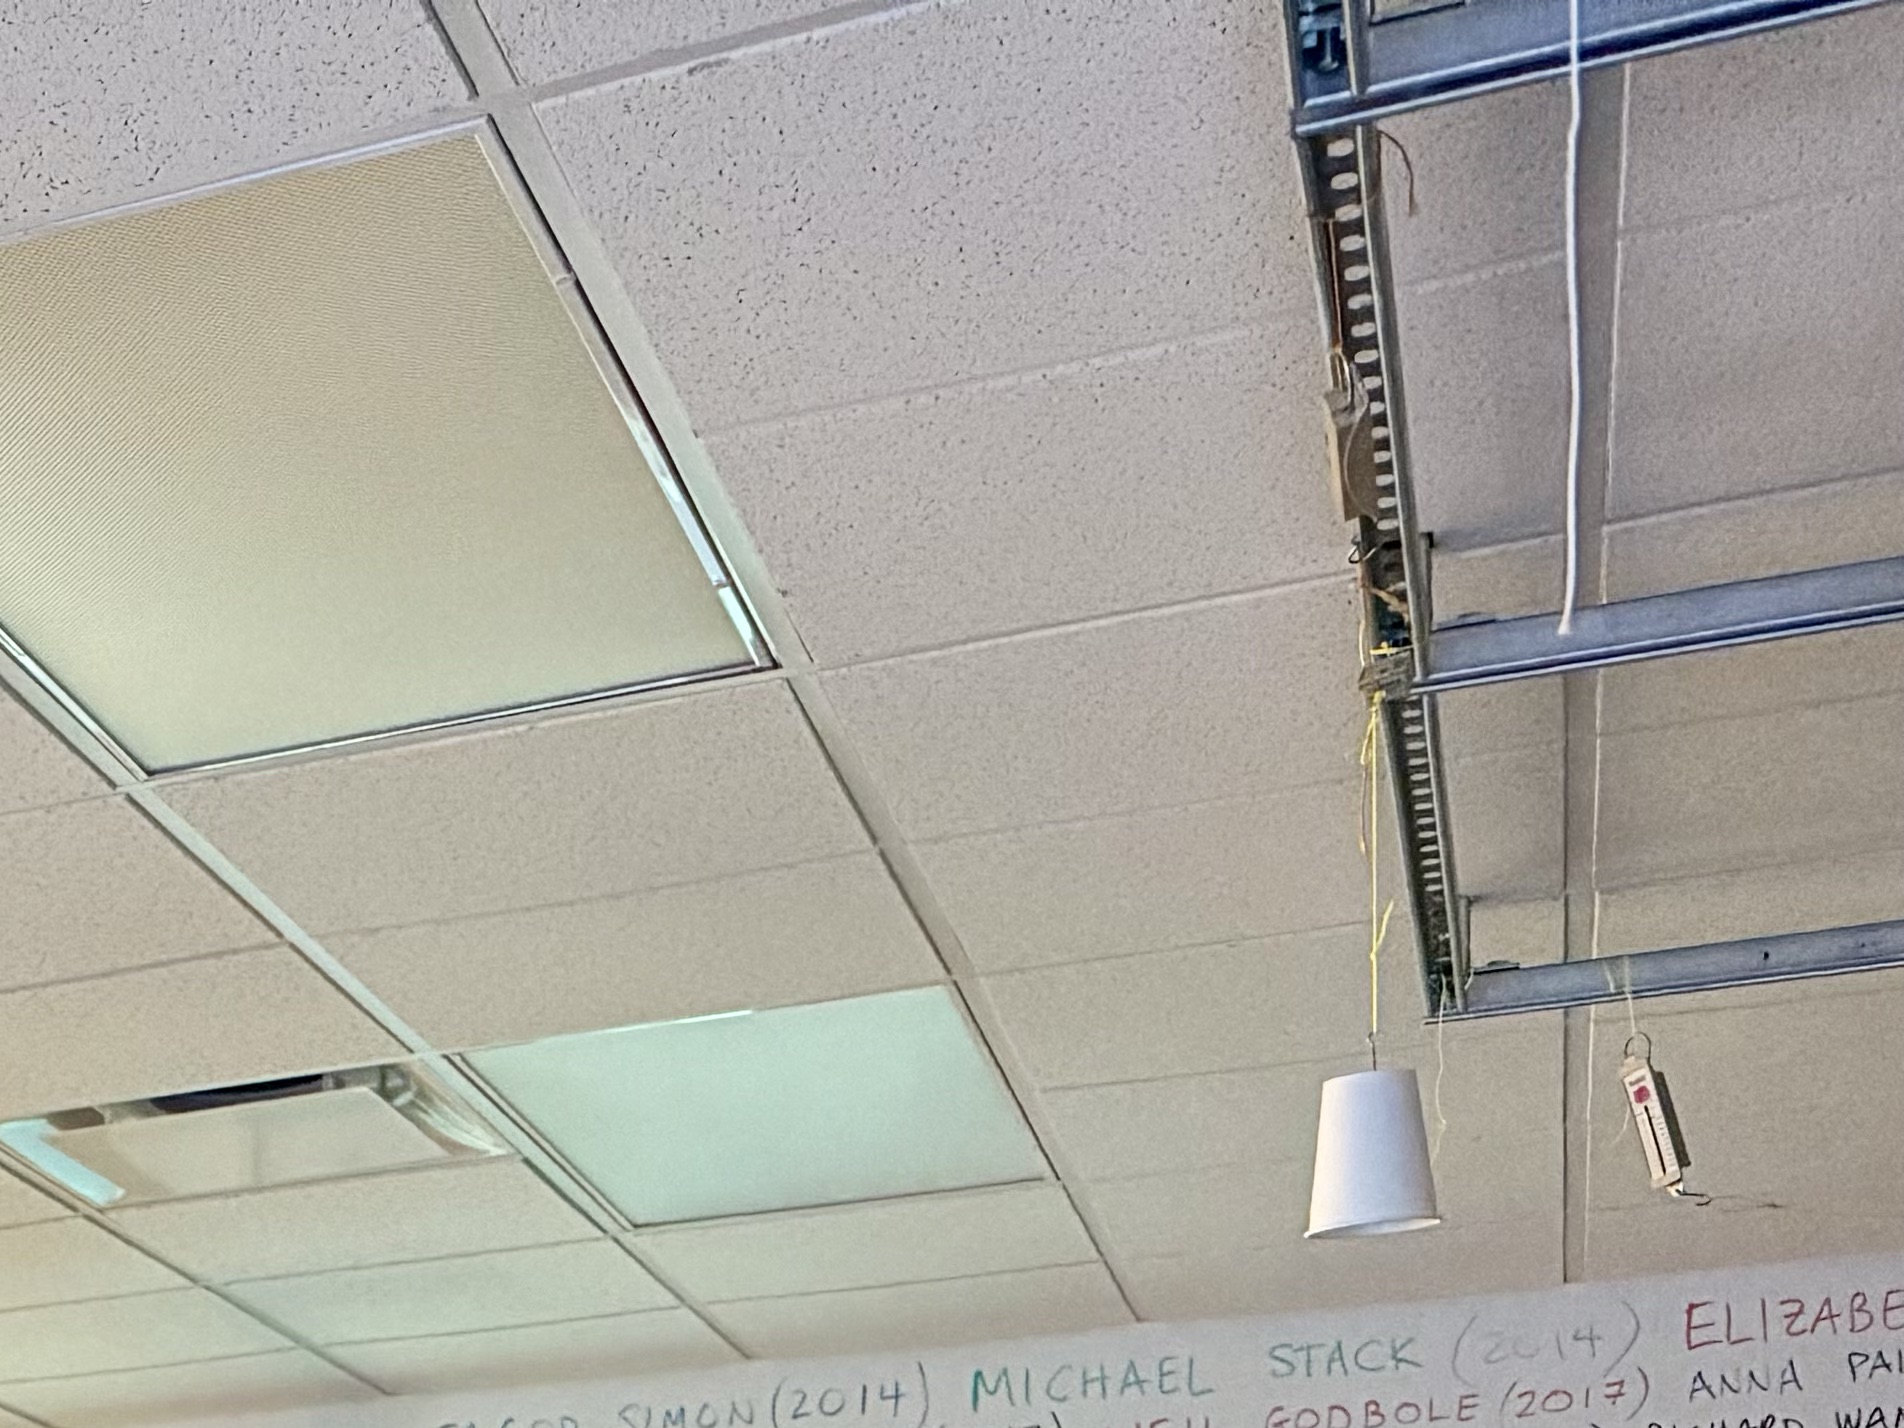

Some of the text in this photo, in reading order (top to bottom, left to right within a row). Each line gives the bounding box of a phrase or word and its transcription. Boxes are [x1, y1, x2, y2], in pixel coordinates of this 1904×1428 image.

[971, 1356, 1214, 1413] MICHAEL
[1268, 1336, 1424, 1378] STACK
[1689, 1360, 1803, 1402] ANNA
